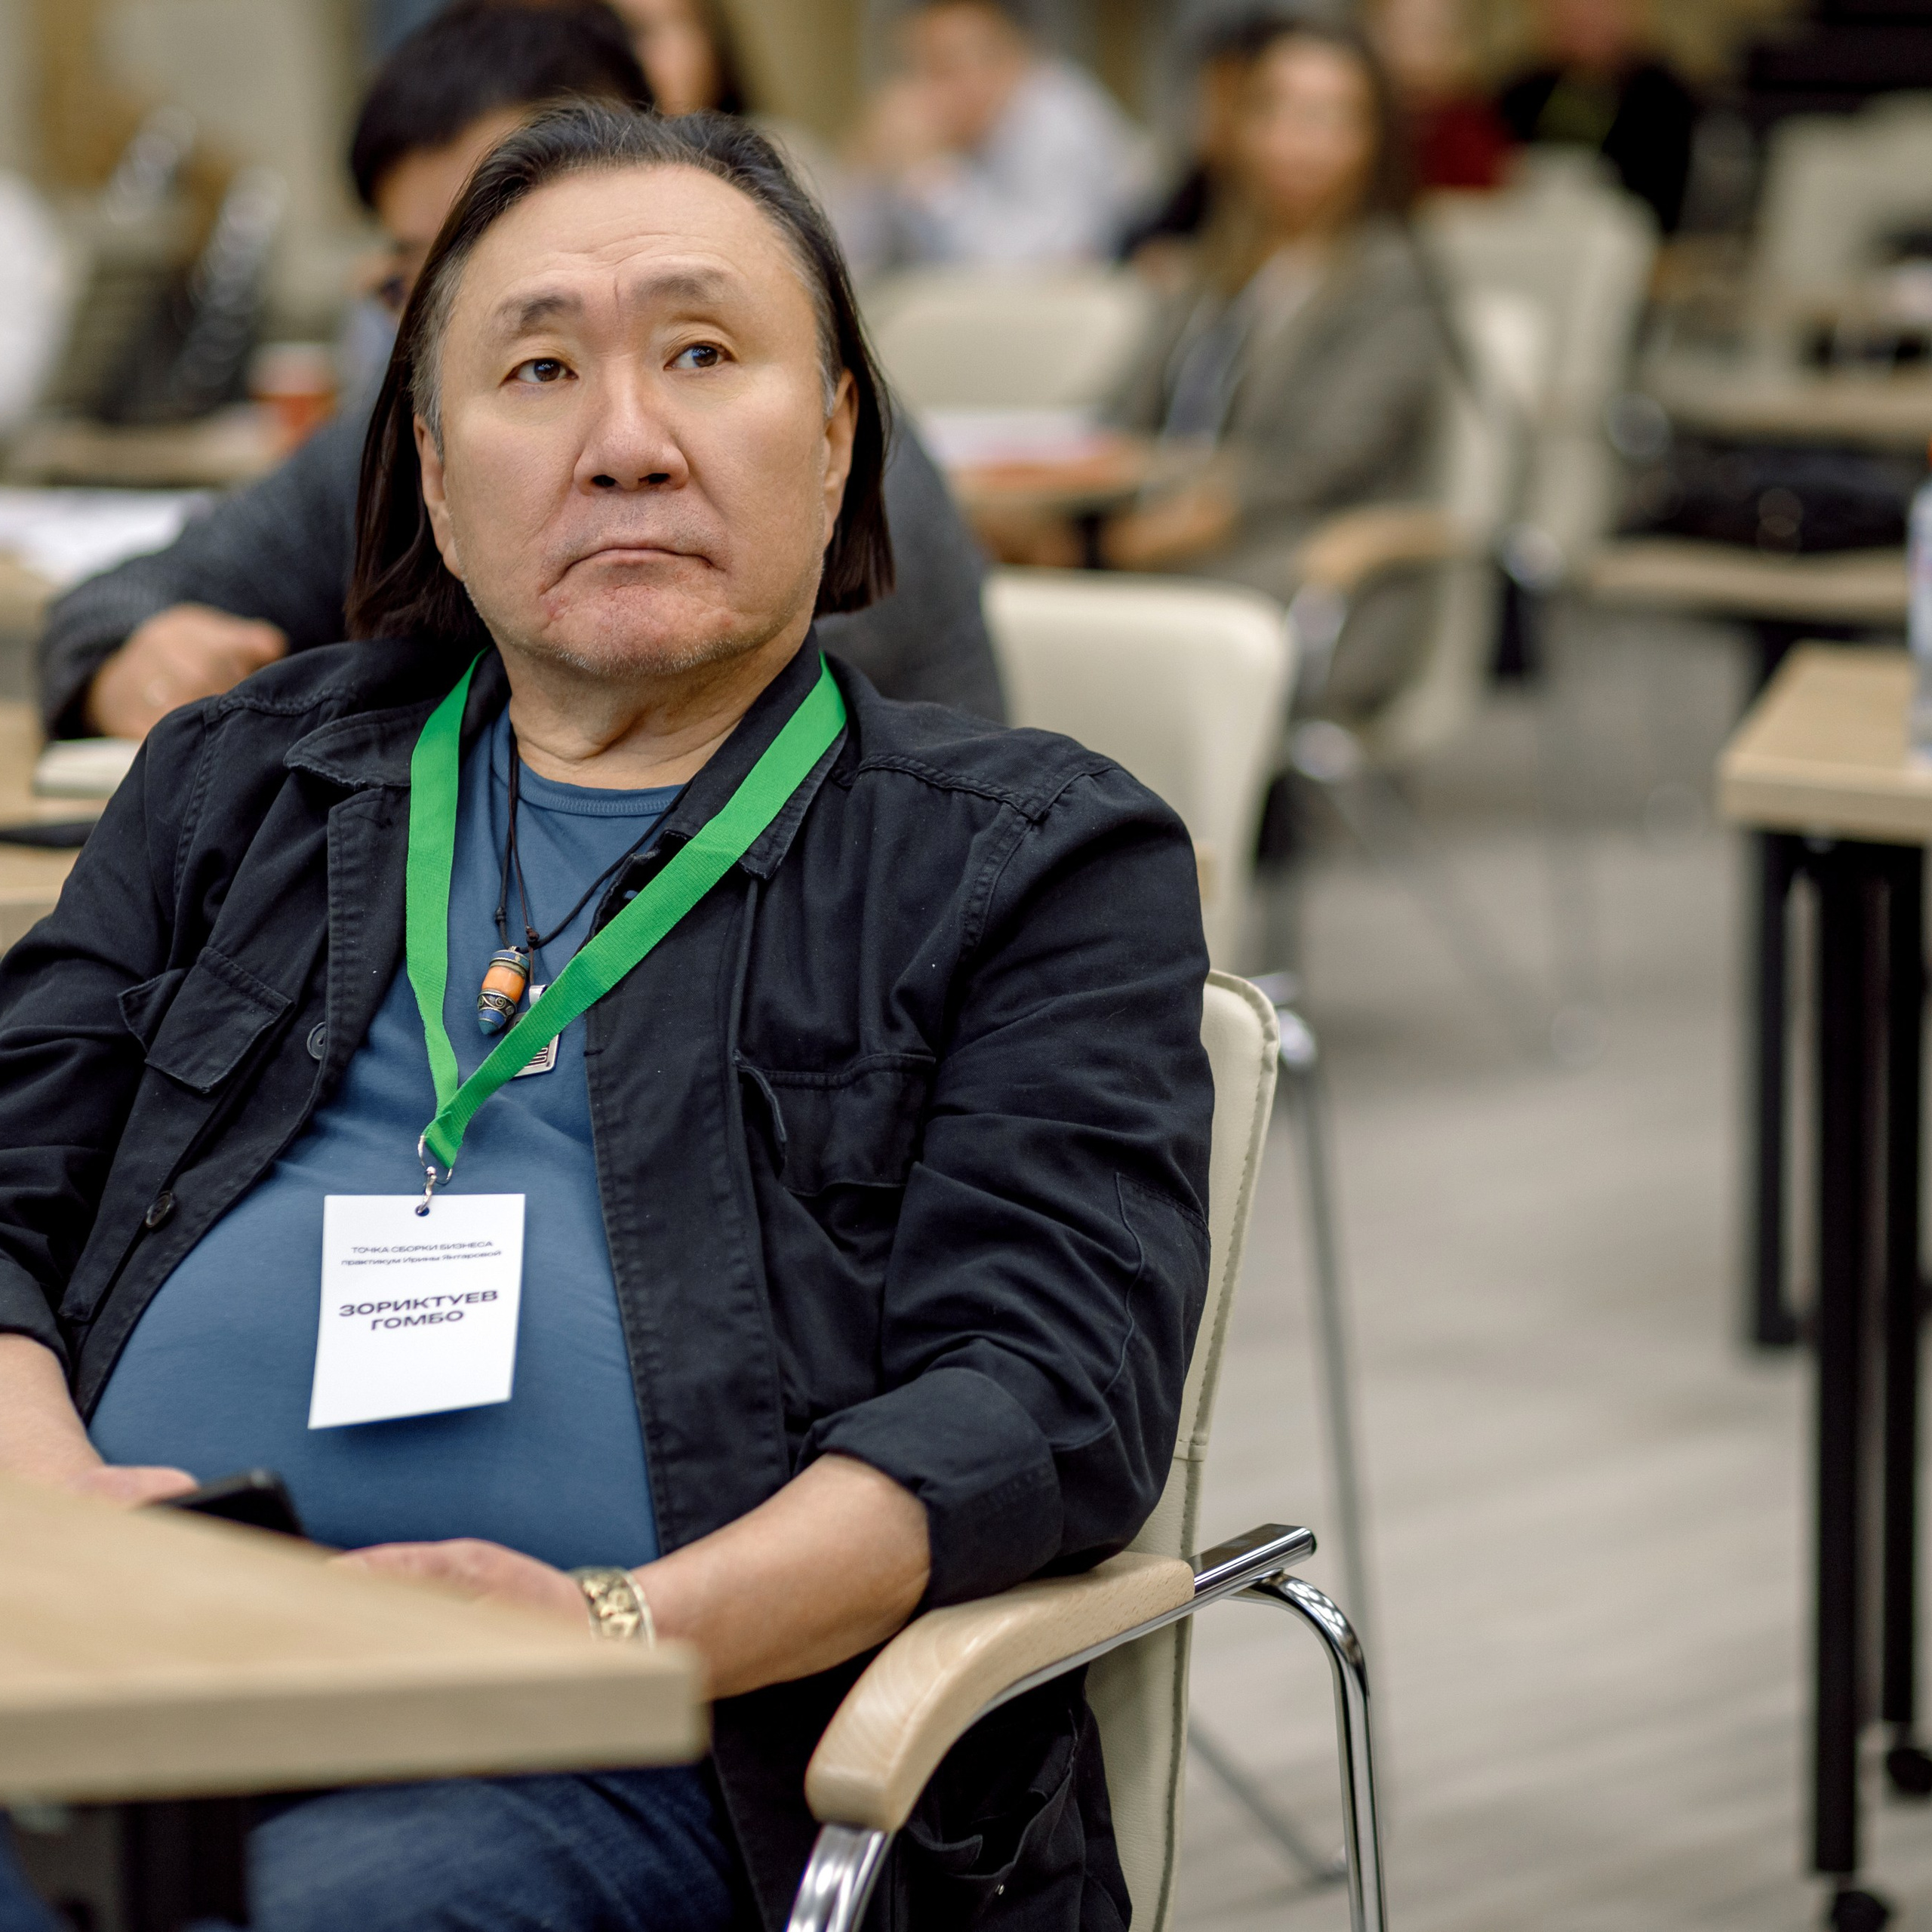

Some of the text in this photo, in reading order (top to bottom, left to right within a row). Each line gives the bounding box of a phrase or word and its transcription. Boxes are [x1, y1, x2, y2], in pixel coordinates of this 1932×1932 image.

[390, 1244, 438, 1253] СБОРКИ
[439, 1241, 493, 1251] БИЗНЕСА
[341, 1258, 401, 1266] практикум
[339, 1290, 498, 1317] ЗОРИКТУЕВ
[371, 1310, 464, 1331] ГОМБО
